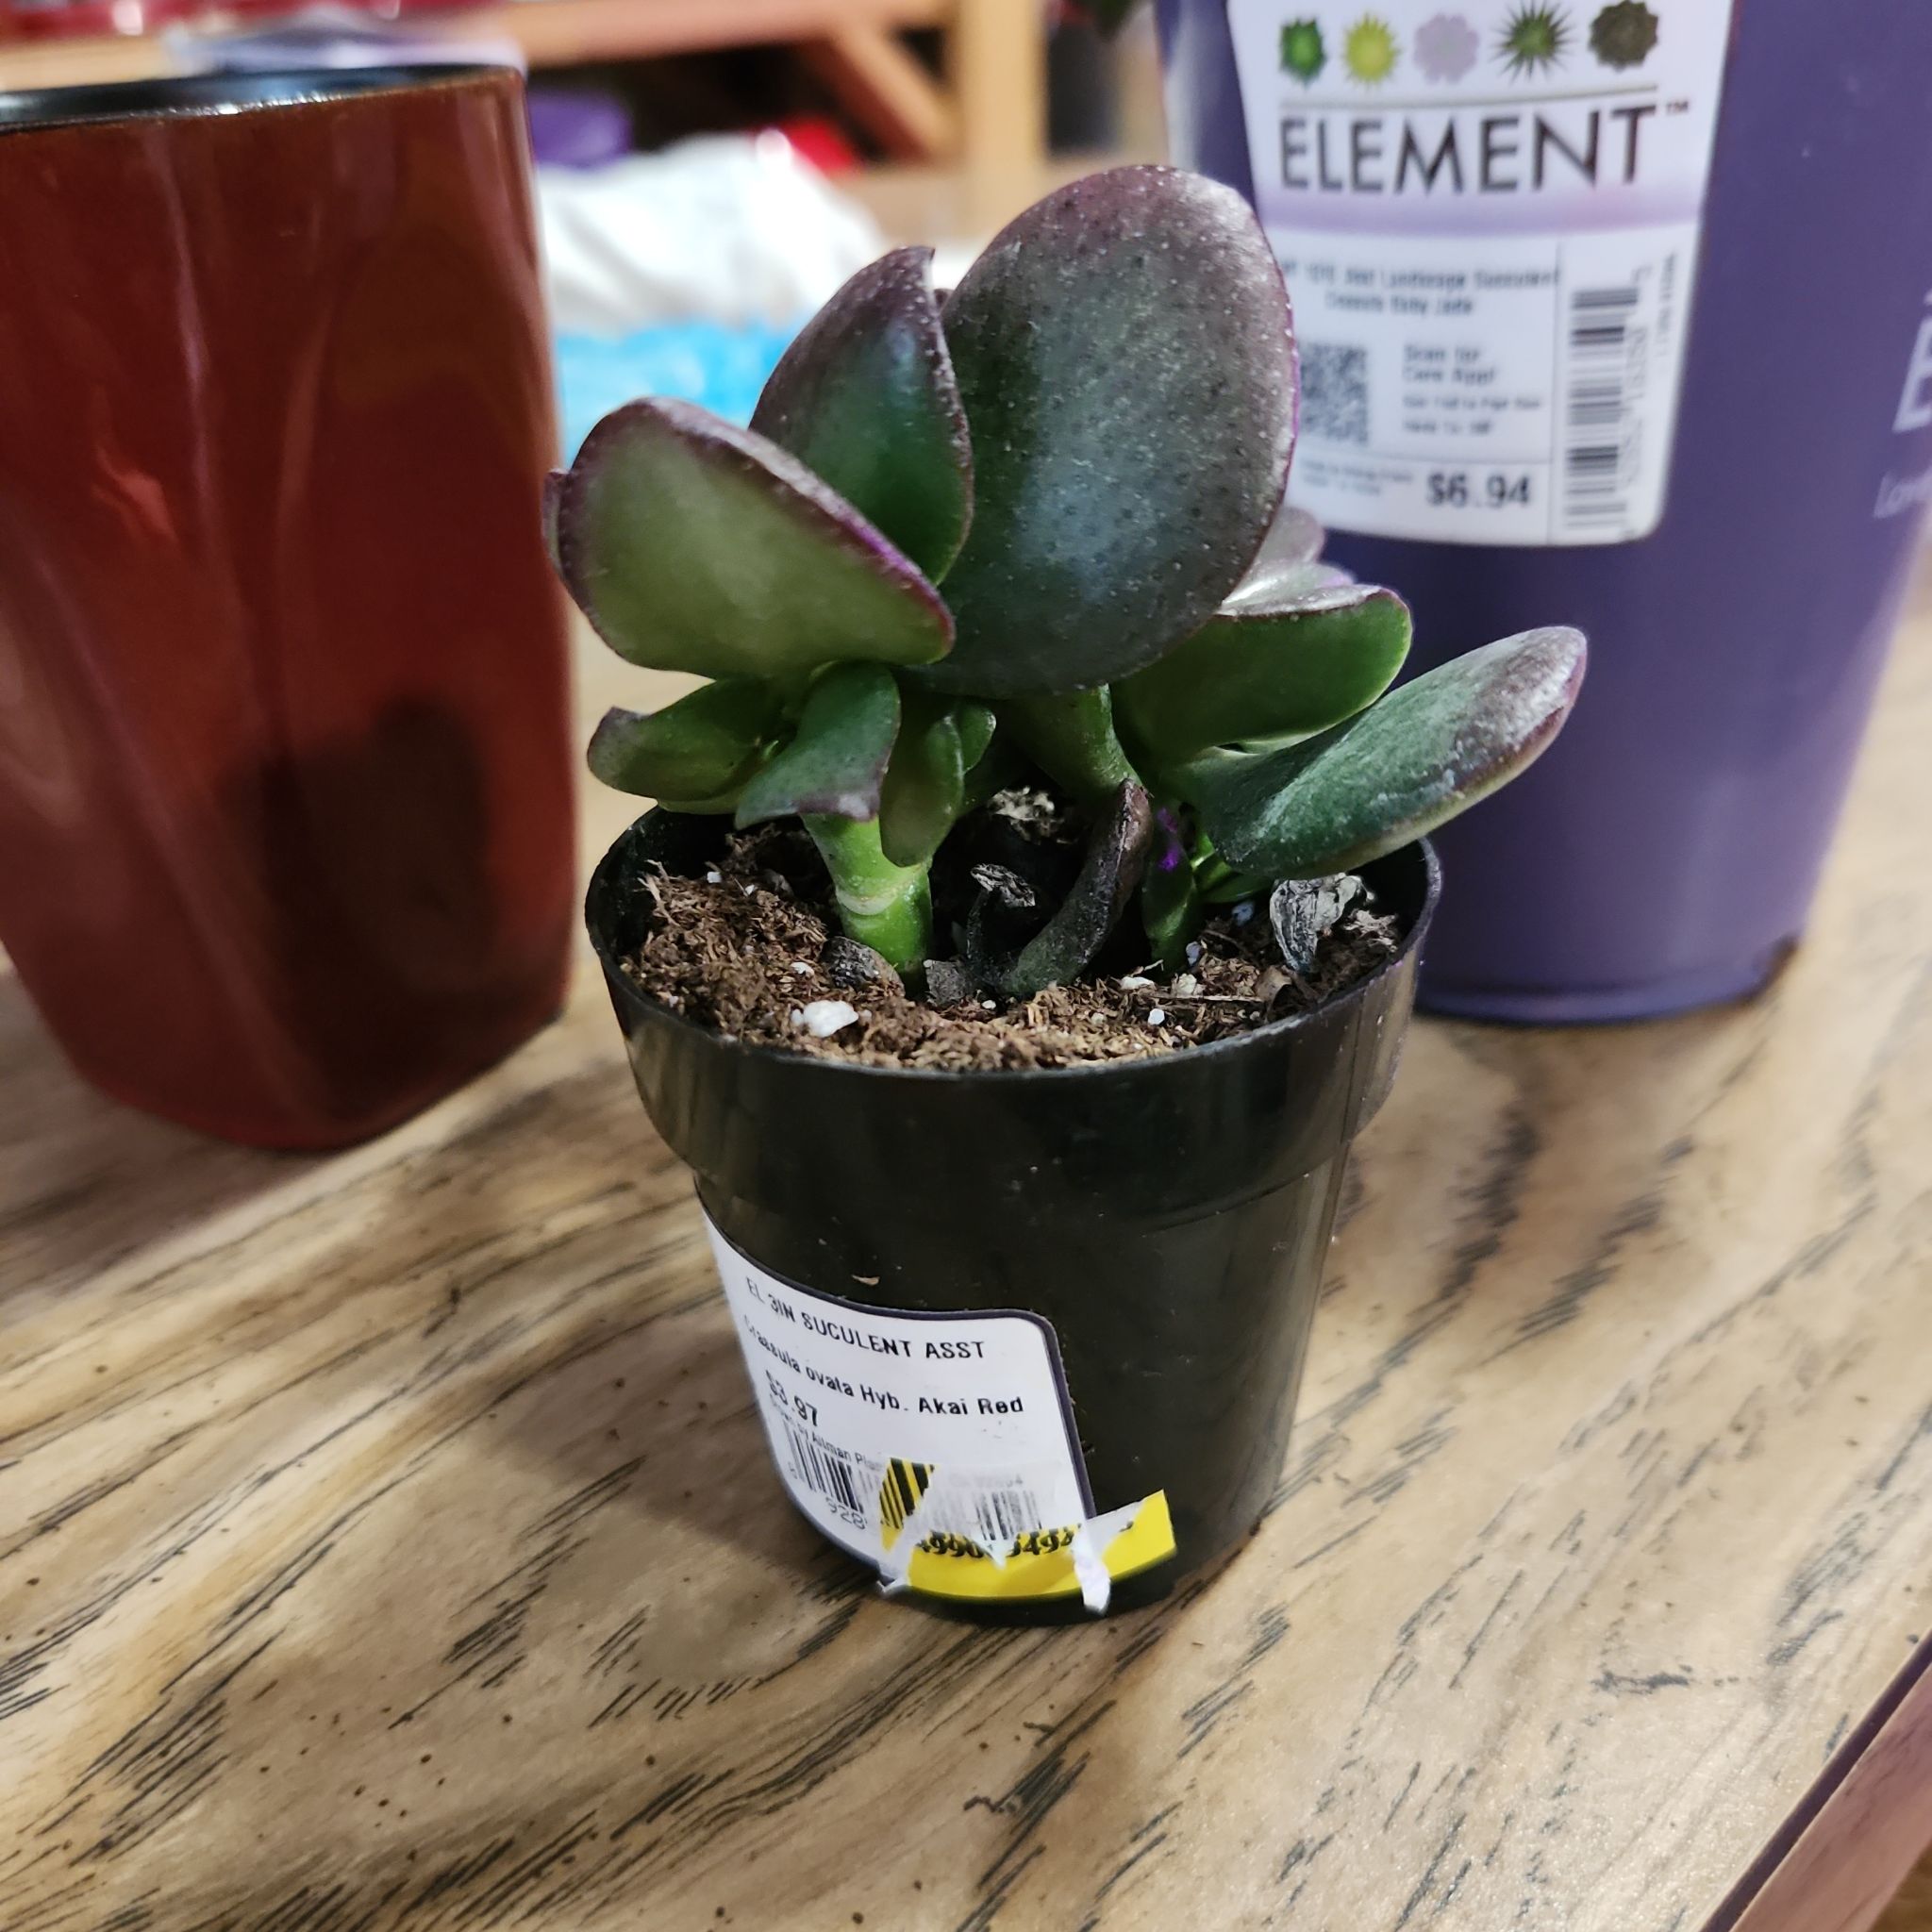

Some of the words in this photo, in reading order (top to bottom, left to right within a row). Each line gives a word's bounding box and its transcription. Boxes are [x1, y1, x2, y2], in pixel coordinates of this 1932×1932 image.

[1279, 104, 1657, 196] ELEMENT
[1427, 473, 1529, 508] $6.94
[746, 1276, 765, 1304] EL
[768, 1293, 795, 1323] 3IN
[801, 1311, 912, 1358] SUCULENT
[925, 1341, 985, 1359] ASST
[766, 1370, 818, 1427] $3.97
[860, 1384, 909, 1411] Hyb.
[919, 1397, 969, 1415] Akai
[977, 1396, 1024, 1415] Red
